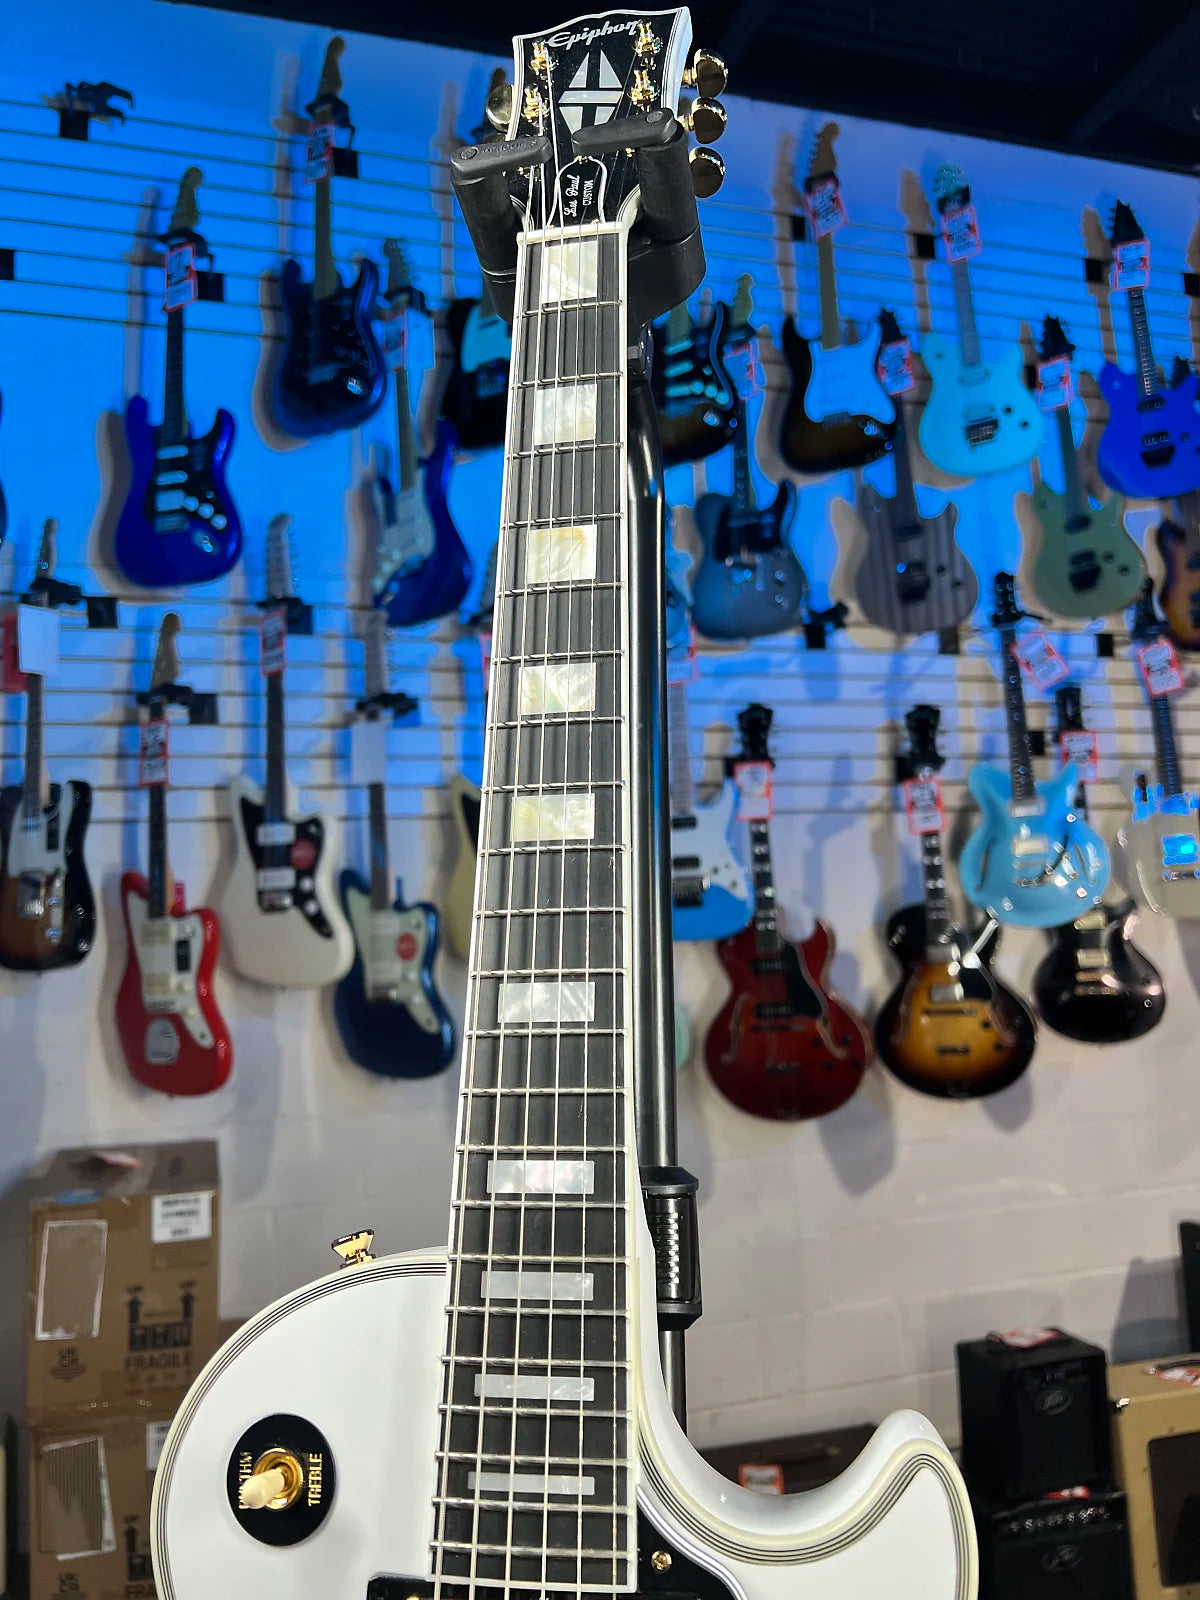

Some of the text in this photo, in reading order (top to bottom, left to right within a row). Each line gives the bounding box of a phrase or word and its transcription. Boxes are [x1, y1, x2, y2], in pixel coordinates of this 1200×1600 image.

[544, 19, 642, 50] Epiphon
[563, 174, 580, 218] Les Paul
[582, 179, 594, 206] CUSTOM
[308, 1452, 323, 1507] TREBLE
